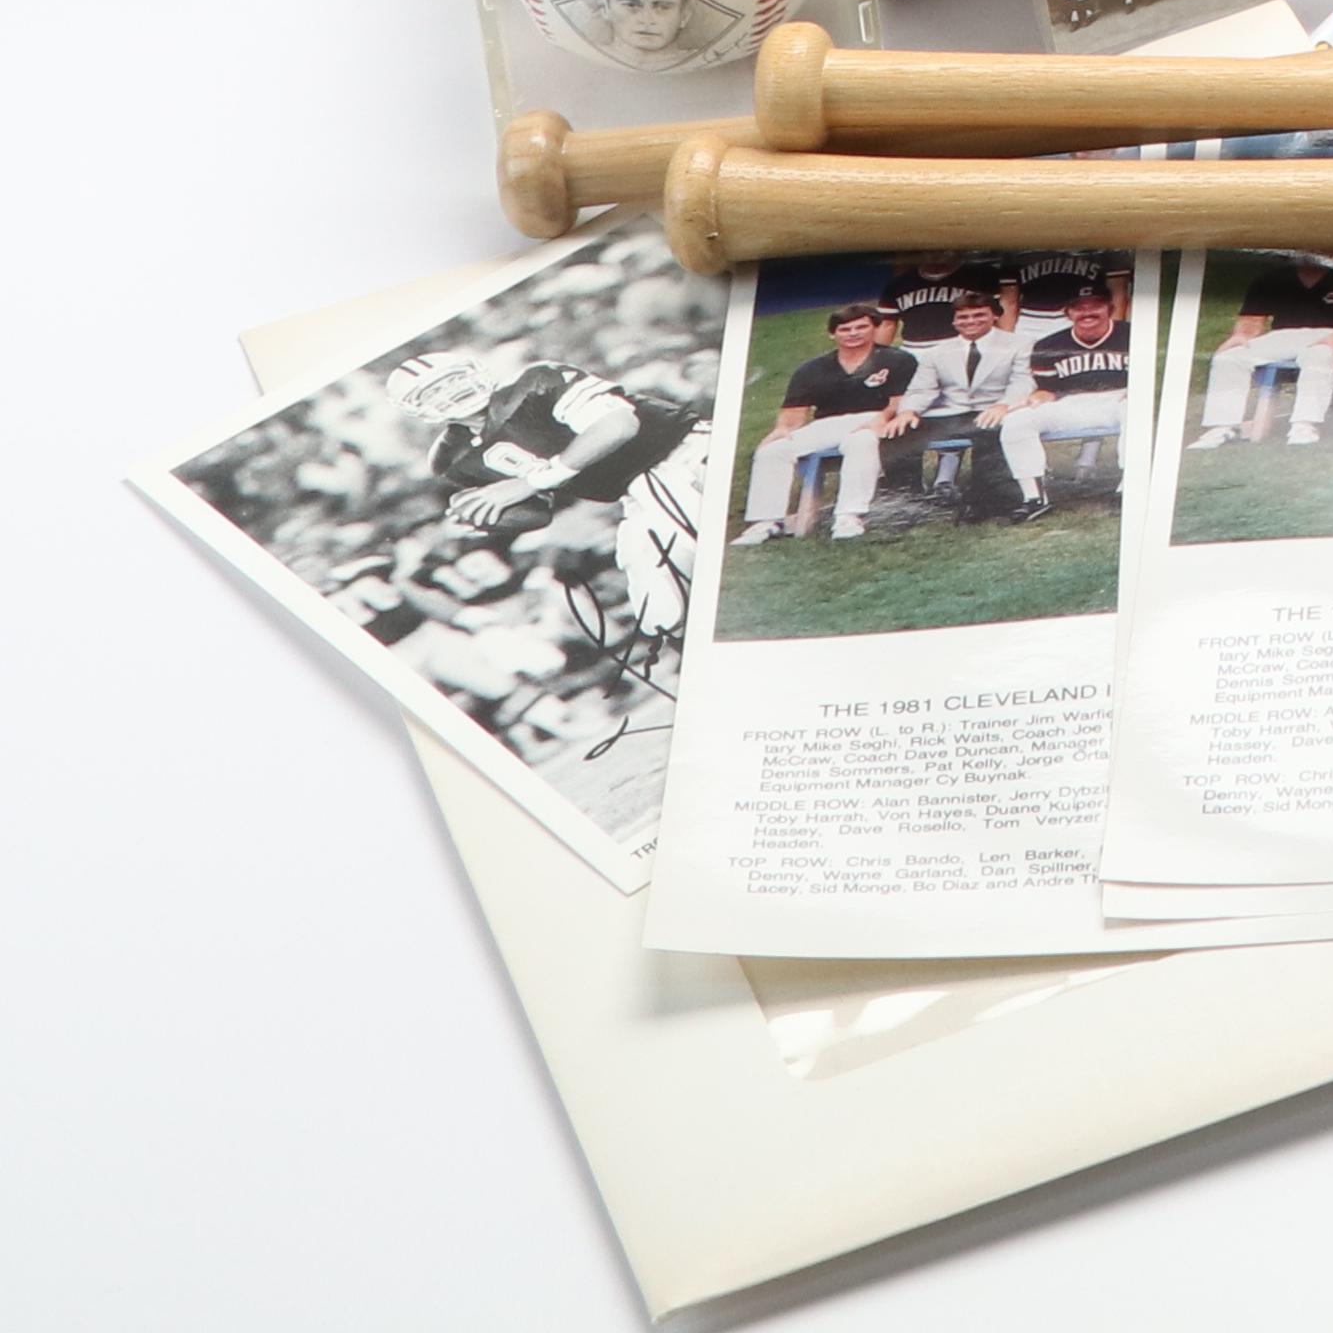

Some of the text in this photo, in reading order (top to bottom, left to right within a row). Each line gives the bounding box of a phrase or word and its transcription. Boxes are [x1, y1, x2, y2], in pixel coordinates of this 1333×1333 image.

[1021, 257, 1100, 284] INDIANS
[1272, 605, 1322, 623] THE
[819, 683, 1098, 719] THE 1981 CLEVELAND
